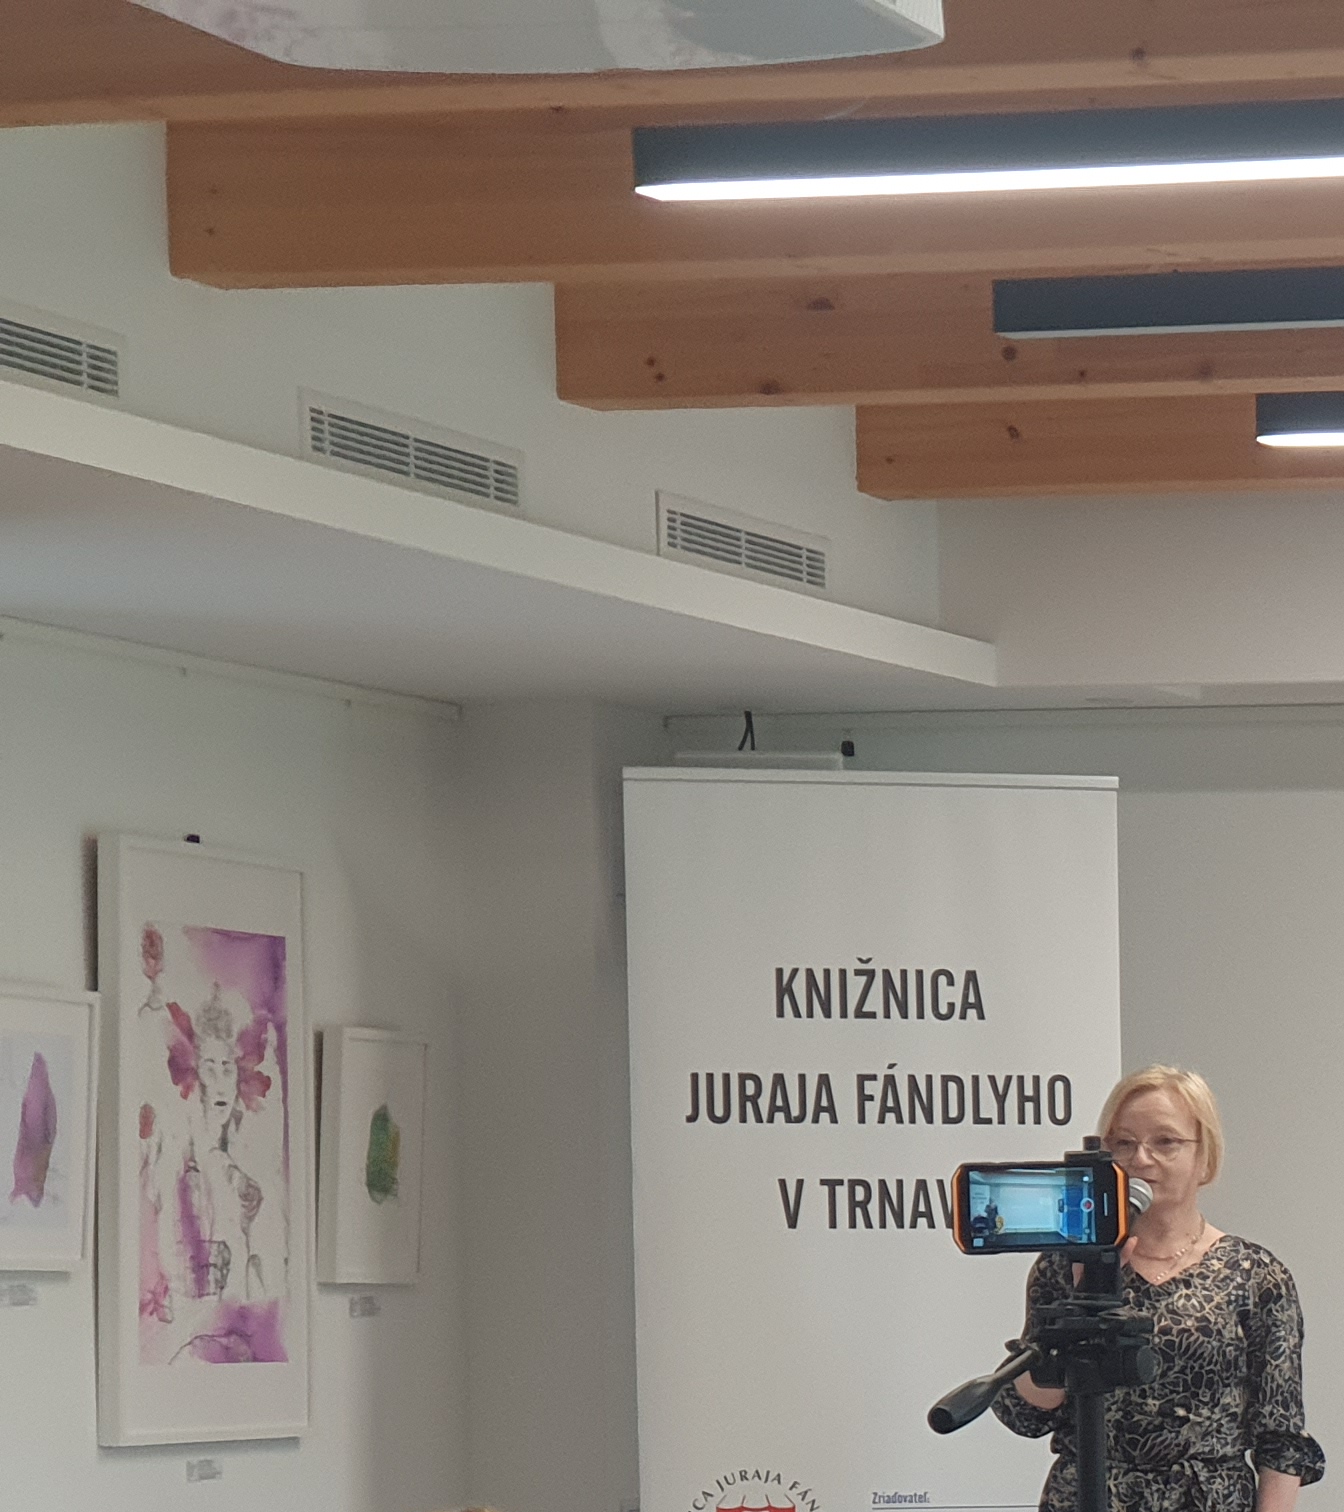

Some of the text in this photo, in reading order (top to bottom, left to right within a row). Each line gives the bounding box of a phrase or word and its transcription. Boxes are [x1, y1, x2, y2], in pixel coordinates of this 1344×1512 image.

[775, 957, 986, 1021] KNIŽNICA
[685, 1062, 1072, 1126] JURAJA FÁNDLYHO
[778, 1178, 954, 1230] V TRNAV
[715, 1469, 783, 1493] JURAJA
